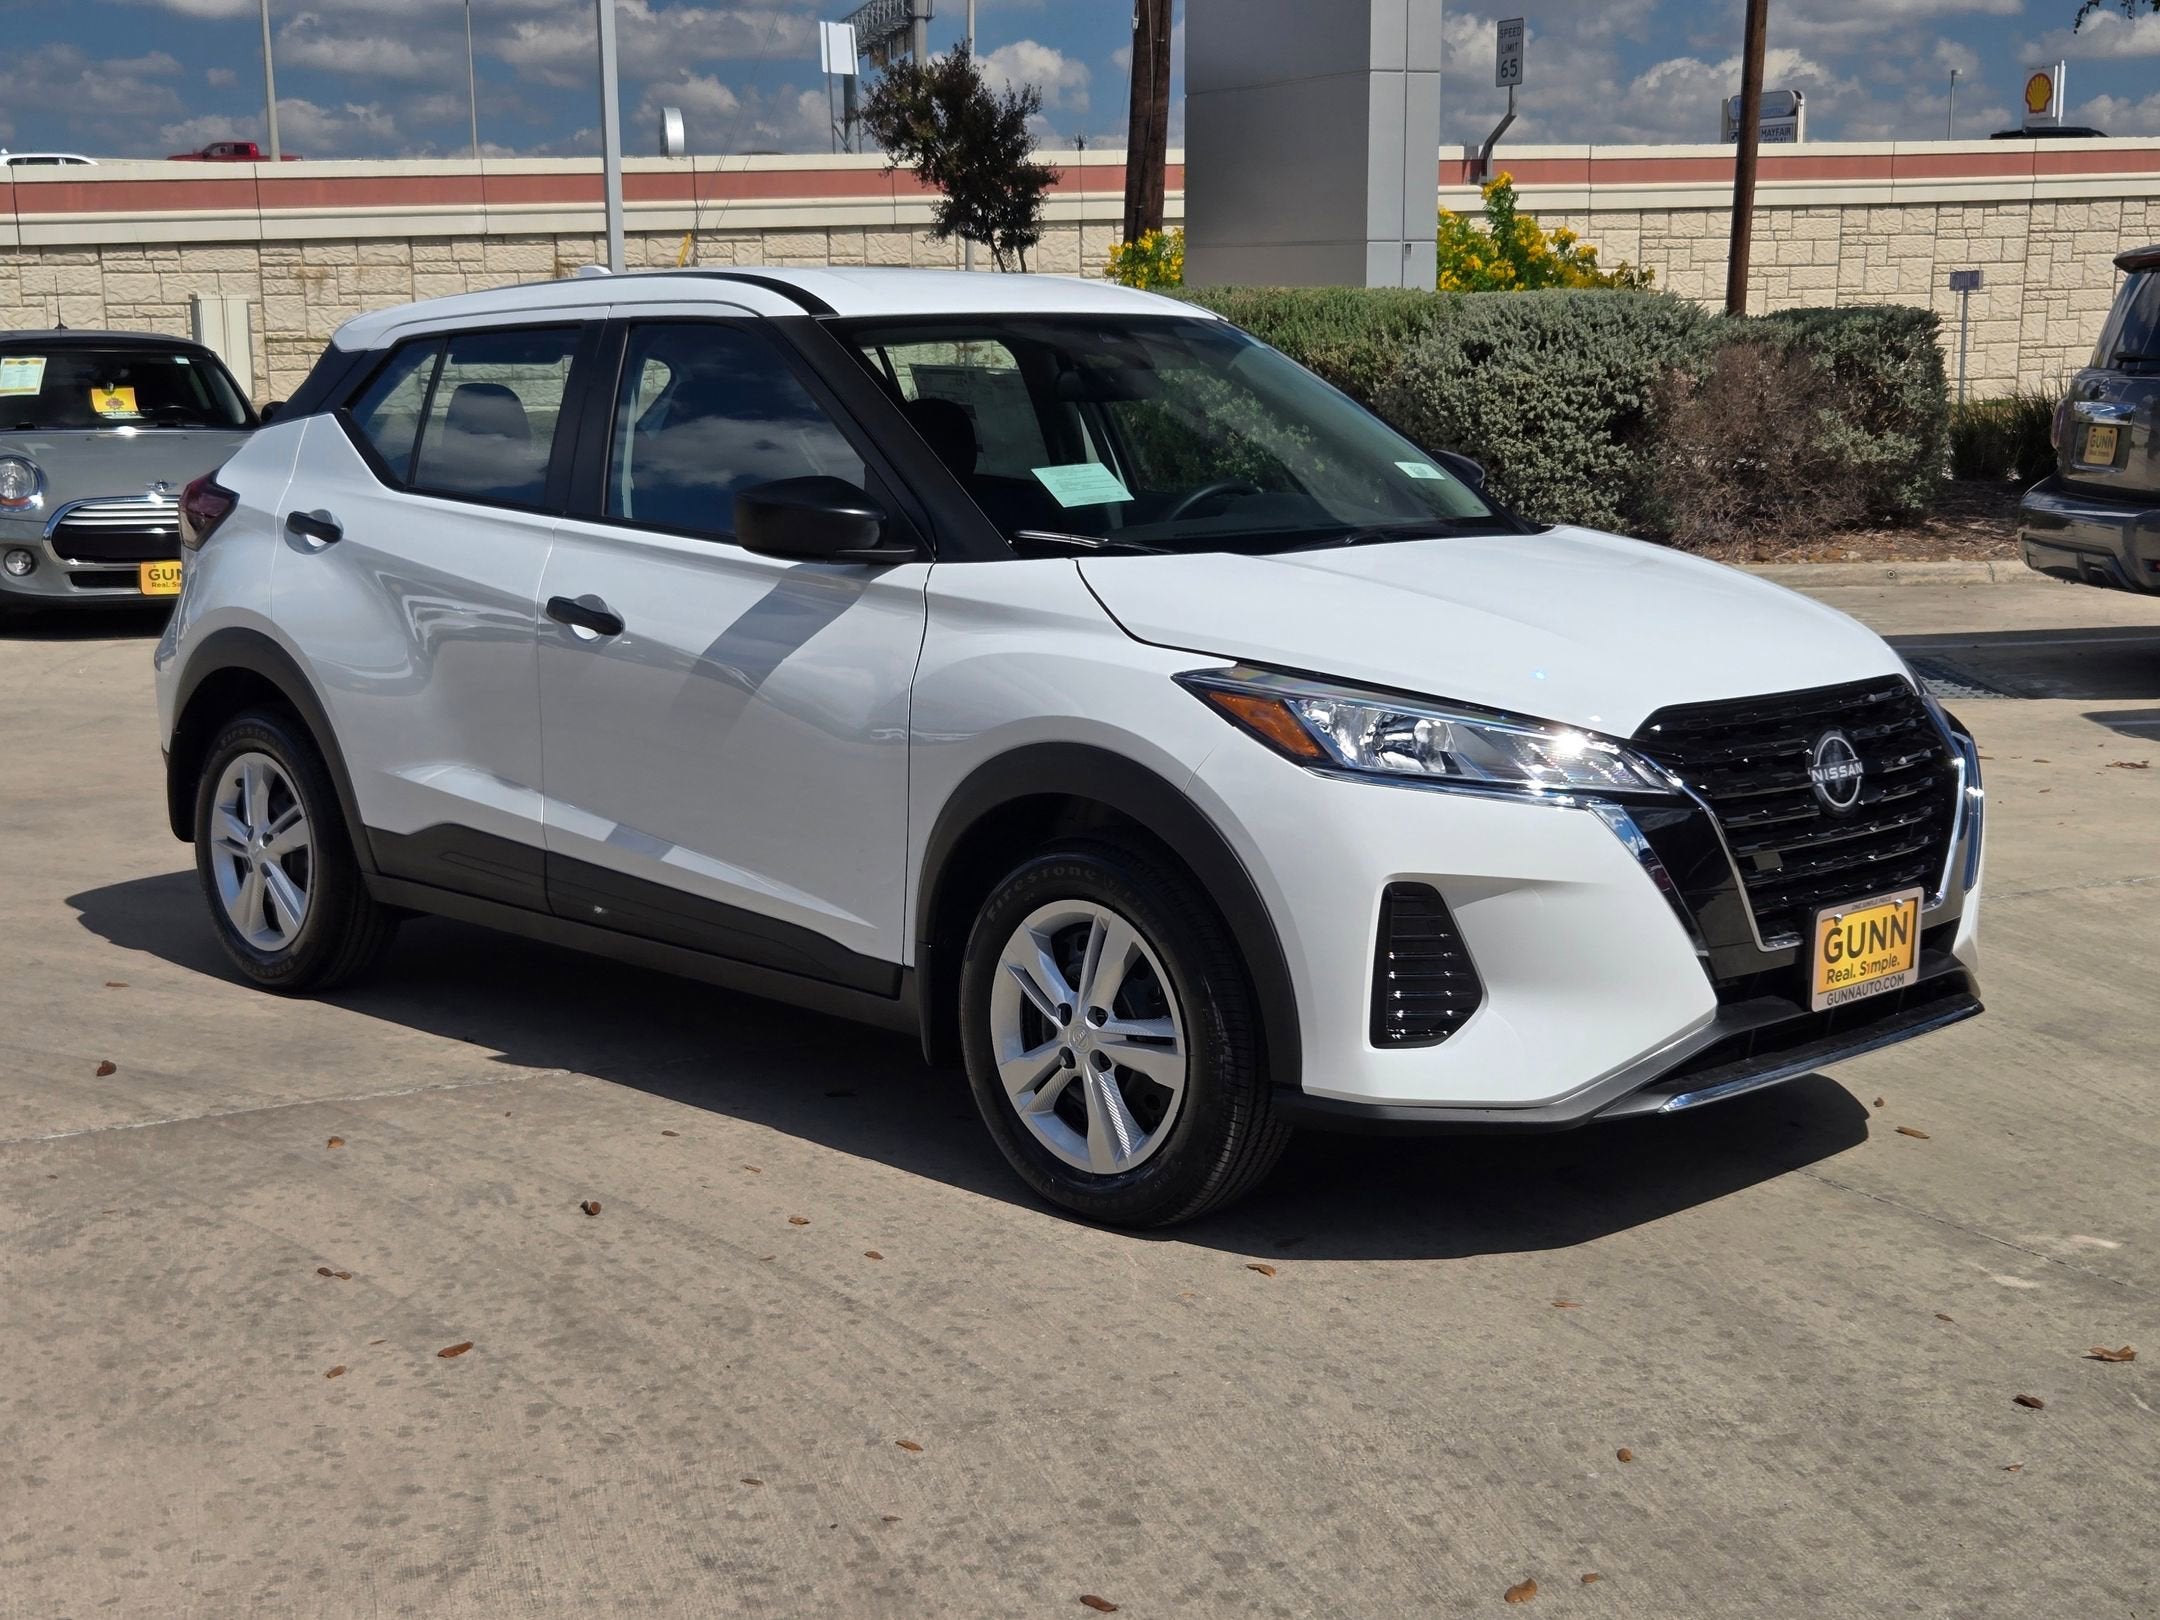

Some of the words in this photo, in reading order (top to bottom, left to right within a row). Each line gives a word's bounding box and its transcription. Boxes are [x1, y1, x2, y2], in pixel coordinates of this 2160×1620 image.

[1499, 26, 1521, 39] SPEED
[1501, 42, 1519, 54] LIMIT
[1501, 58, 1518, 78] 65
[1761, 126, 1791, 138] MAYFAIR
[1811, 761, 1863, 782] NISSAN
[1823, 911, 1908, 964] GUNN
[1826, 963, 1856, 985] Real.
[1826, 973, 1905, 1006] GUNNAUTO.COM
